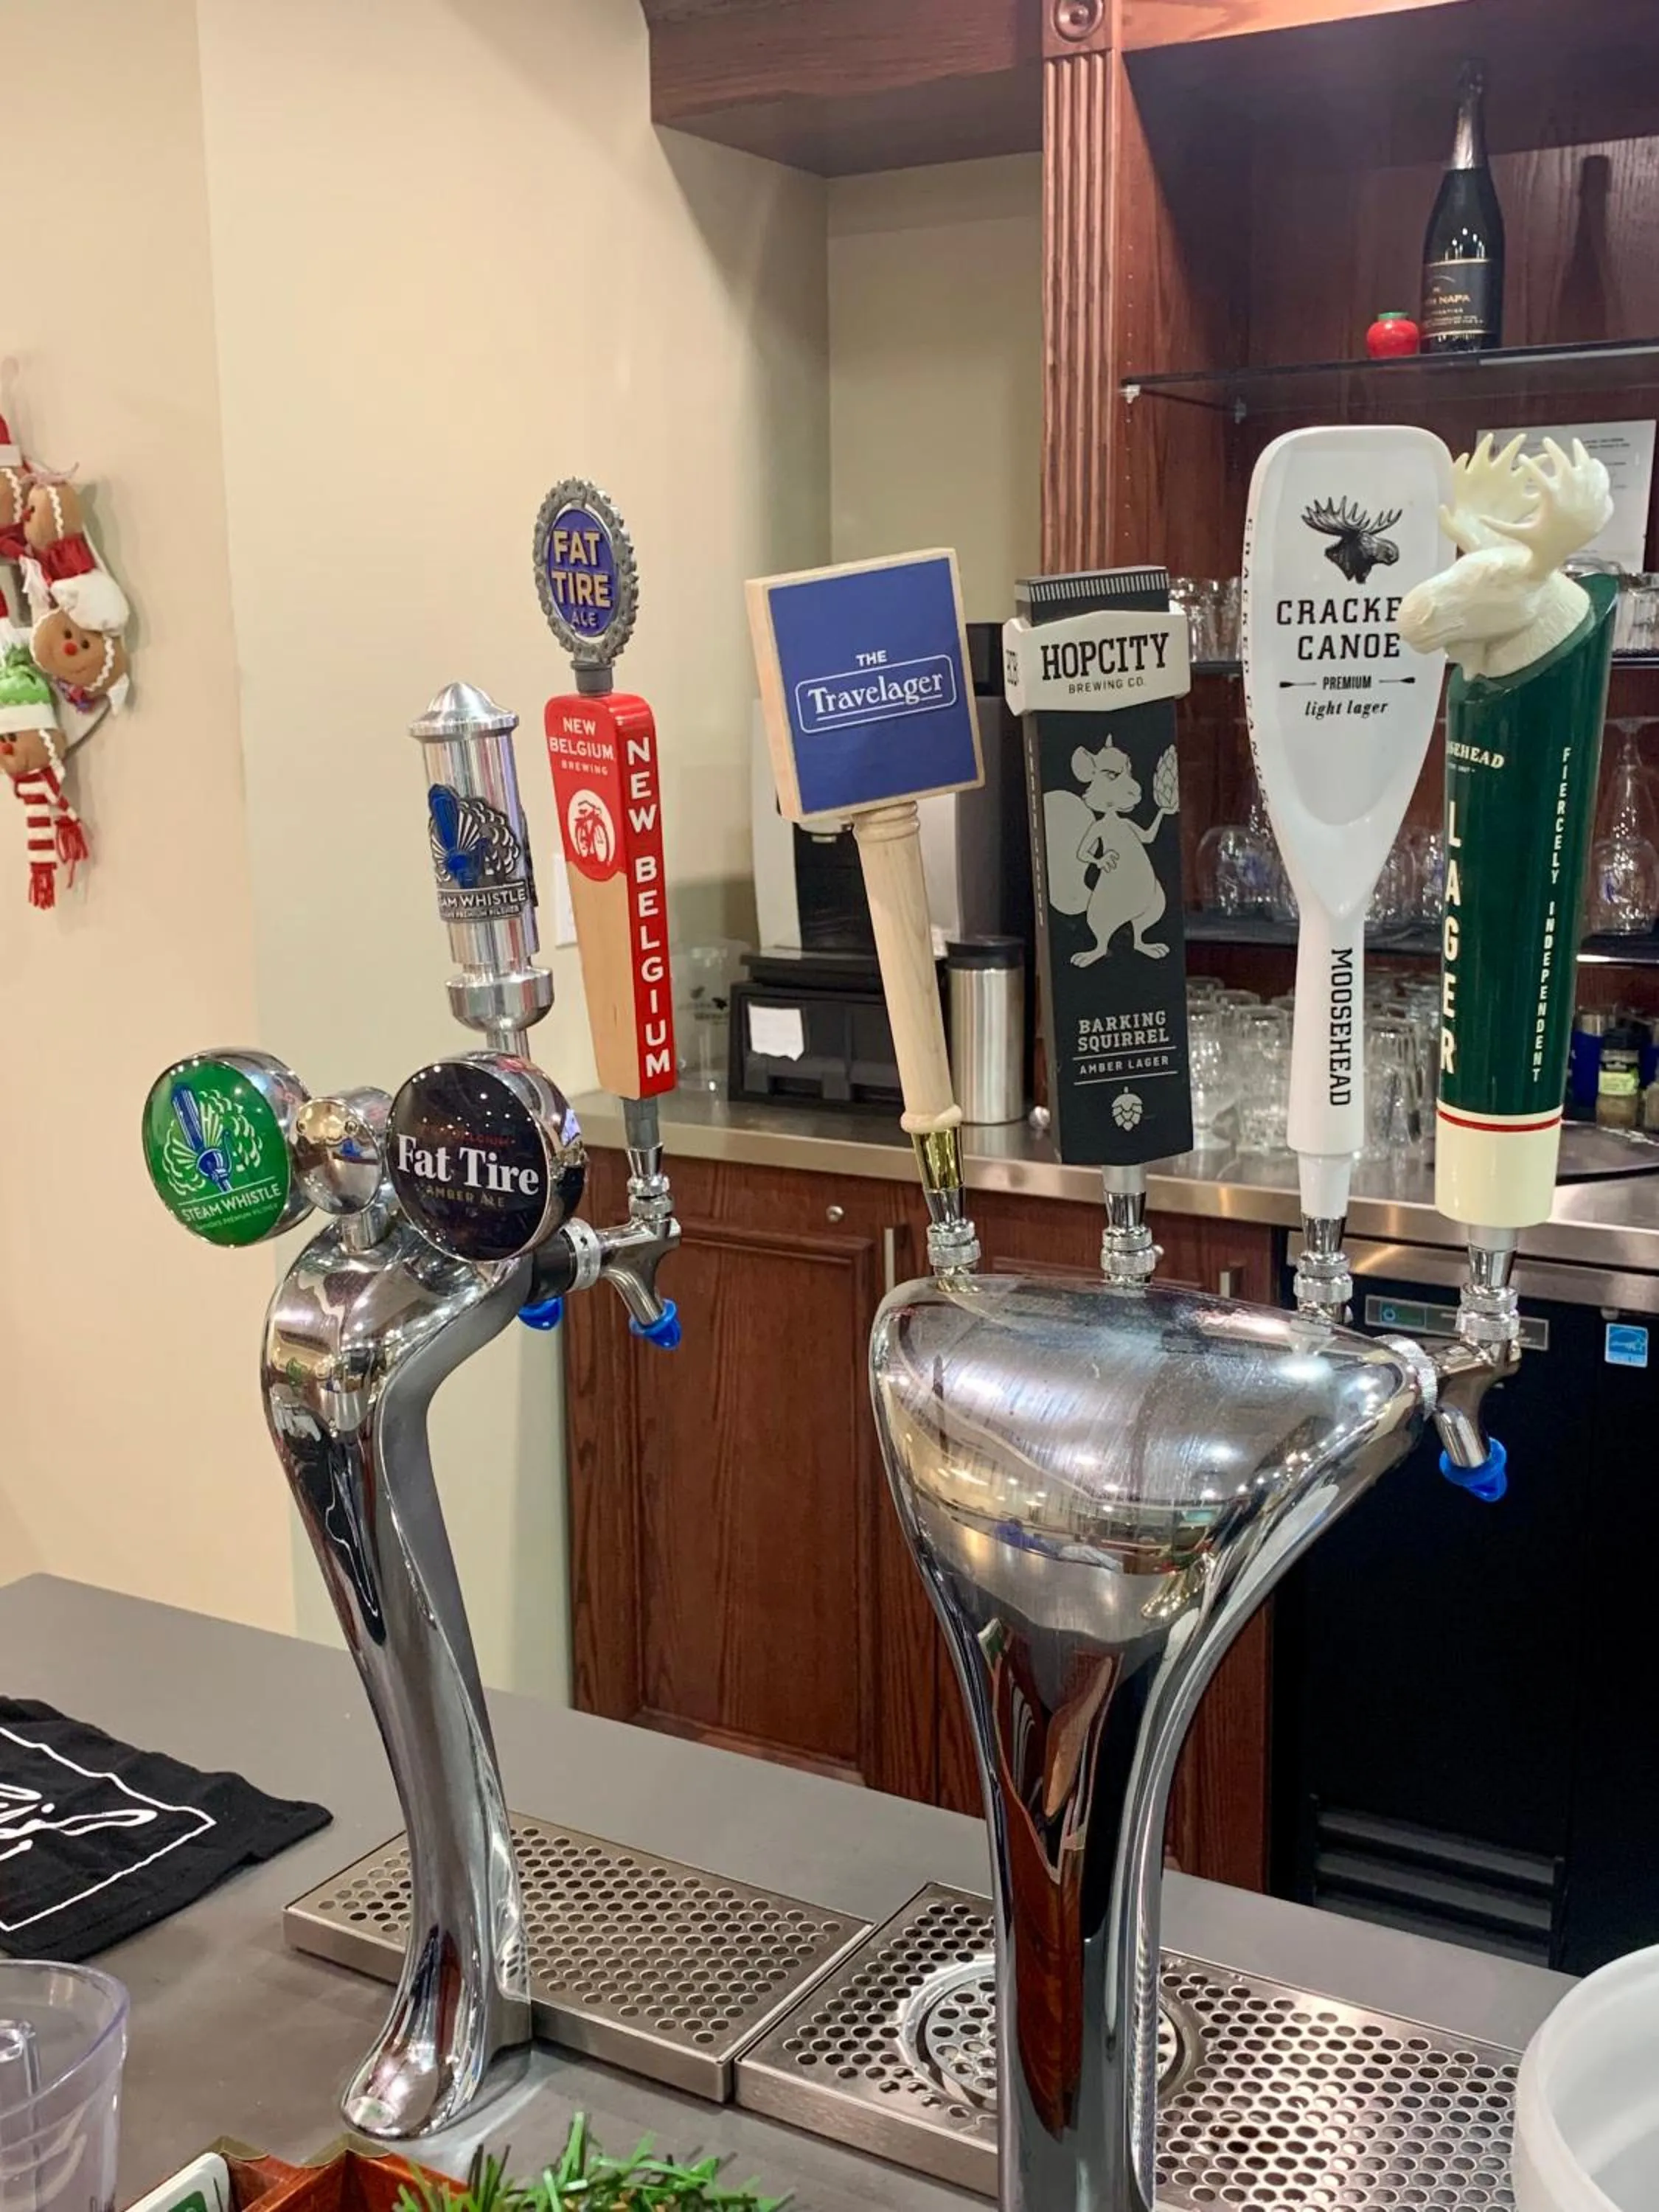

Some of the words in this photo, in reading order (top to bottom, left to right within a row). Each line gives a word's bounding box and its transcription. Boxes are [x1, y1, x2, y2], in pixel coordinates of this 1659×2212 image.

[1439, 294, 1471, 305] NAPA
[553, 531, 601, 566] FAT
[552, 571, 611, 608] TIRE
[571, 611, 598, 627] ALE
[1276, 597, 1403, 625] CRACKE
[855, 650, 888, 667] THE
[1040, 632, 1169, 681] HOPCITY
[1297, 633, 1401, 661] CANOE
[808, 672, 945, 714] Travelager
[1068, 678, 1124, 694] BREWING
[1322, 675, 1371, 691] PREMIUM
[1304, 700, 1343, 720] light
[1347, 700, 1388, 719] lager
[563, 717, 596, 736] NEW
[549, 737, 613, 760] BELGIUM
[560, 759, 608, 776] BREWING
[627, 737, 657, 833] NEW
[1551, 747, 1571, 884] FIERCELY
[459, 888, 526, 907] WHISTLE
[1440, 801, 1462, 1074] LAGER
[635, 855, 671, 1079] BELGIUM
[1533, 901, 1555, 1082] INDEPENDENT
[1078, 1010, 1166, 1034] BARKING
[1329, 947, 1353, 1106] MOOSEHEAD
[1077, 1027, 1169, 1052] SQUIRREL
[1079, 1060, 1123, 1074] AMBER
[1127, 1055, 1169, 1069] LAGER
[396, 1133, 453, 1182] Fat
[459, 1147, 540, 1195] Tire
[181, 1203, 223, 1222] STEAM
[220, 1183, 282, 1211] WHISTLE
[426, 1184, 475, 1203] AMBER
